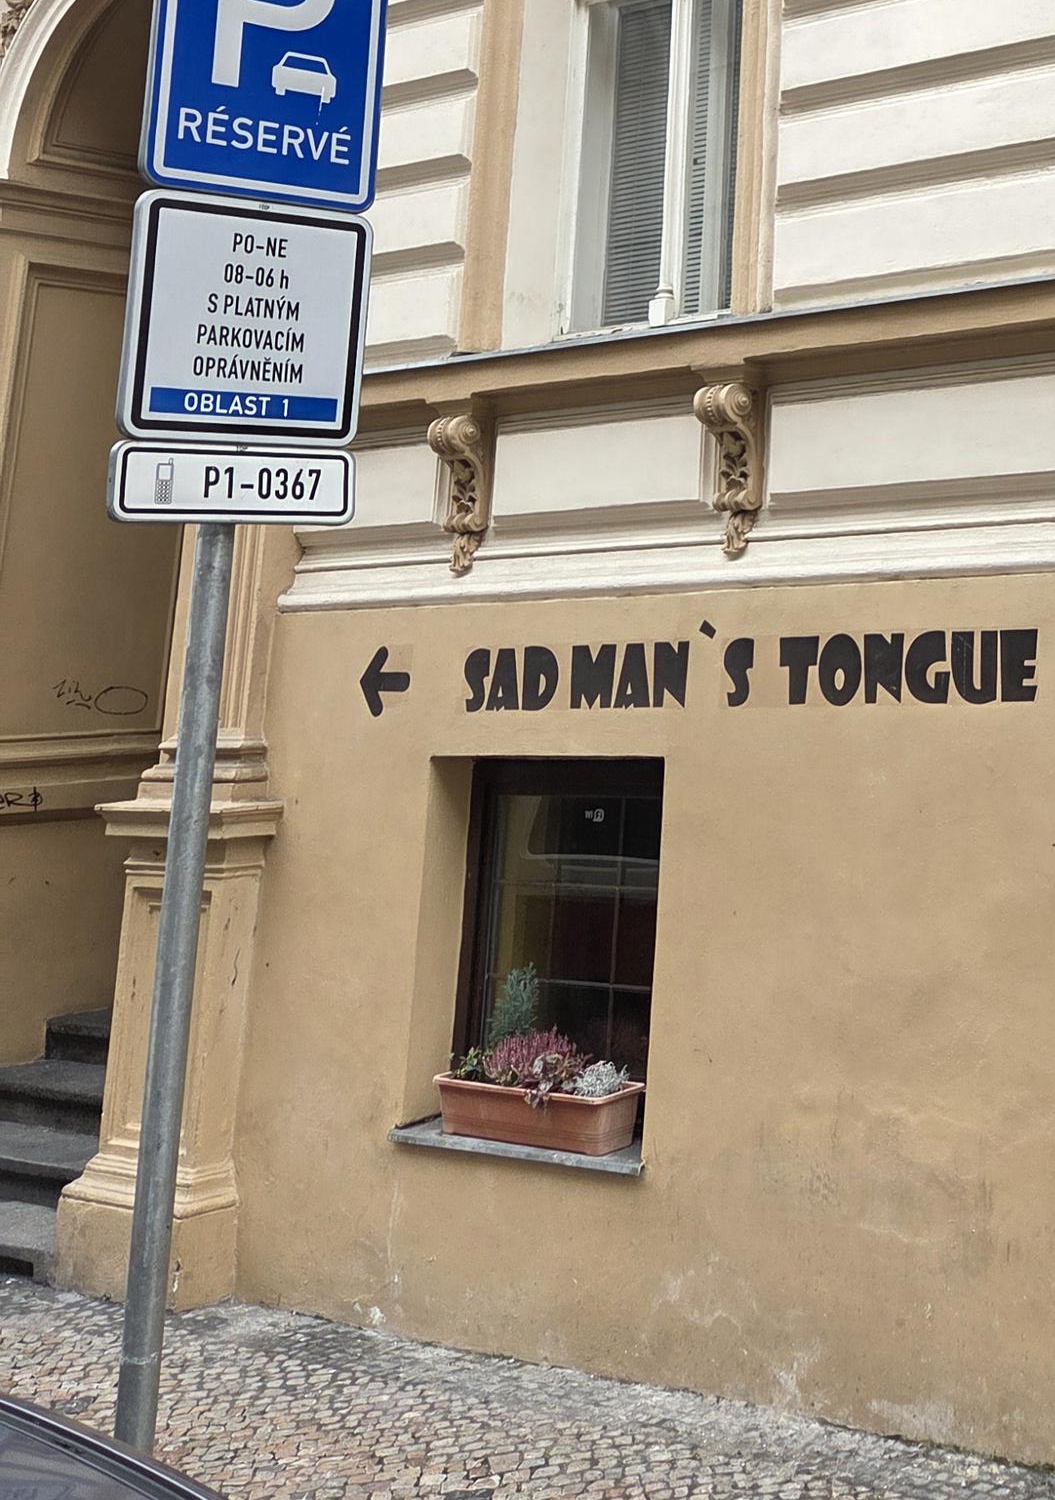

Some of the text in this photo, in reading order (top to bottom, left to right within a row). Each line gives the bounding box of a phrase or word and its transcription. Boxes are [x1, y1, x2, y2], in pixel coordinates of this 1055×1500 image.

[177, 105, 351, 165] RÉSERVÉ
[232, 232, 289, 259] PO-NE
[223, 263, 290, 290] 08-06 h
[207, 293, 301, 322] S PLATNÝM
[196, 323, 306, 353] PARKOVACÍM
[193, 354, 304, 384] OPRÁVNĚNÍM
[184, 392, 290, 418] OBLAST 1
[203, 466, 323, 501] P1-0367
[779, 628, 1039, 707] TONGUE
